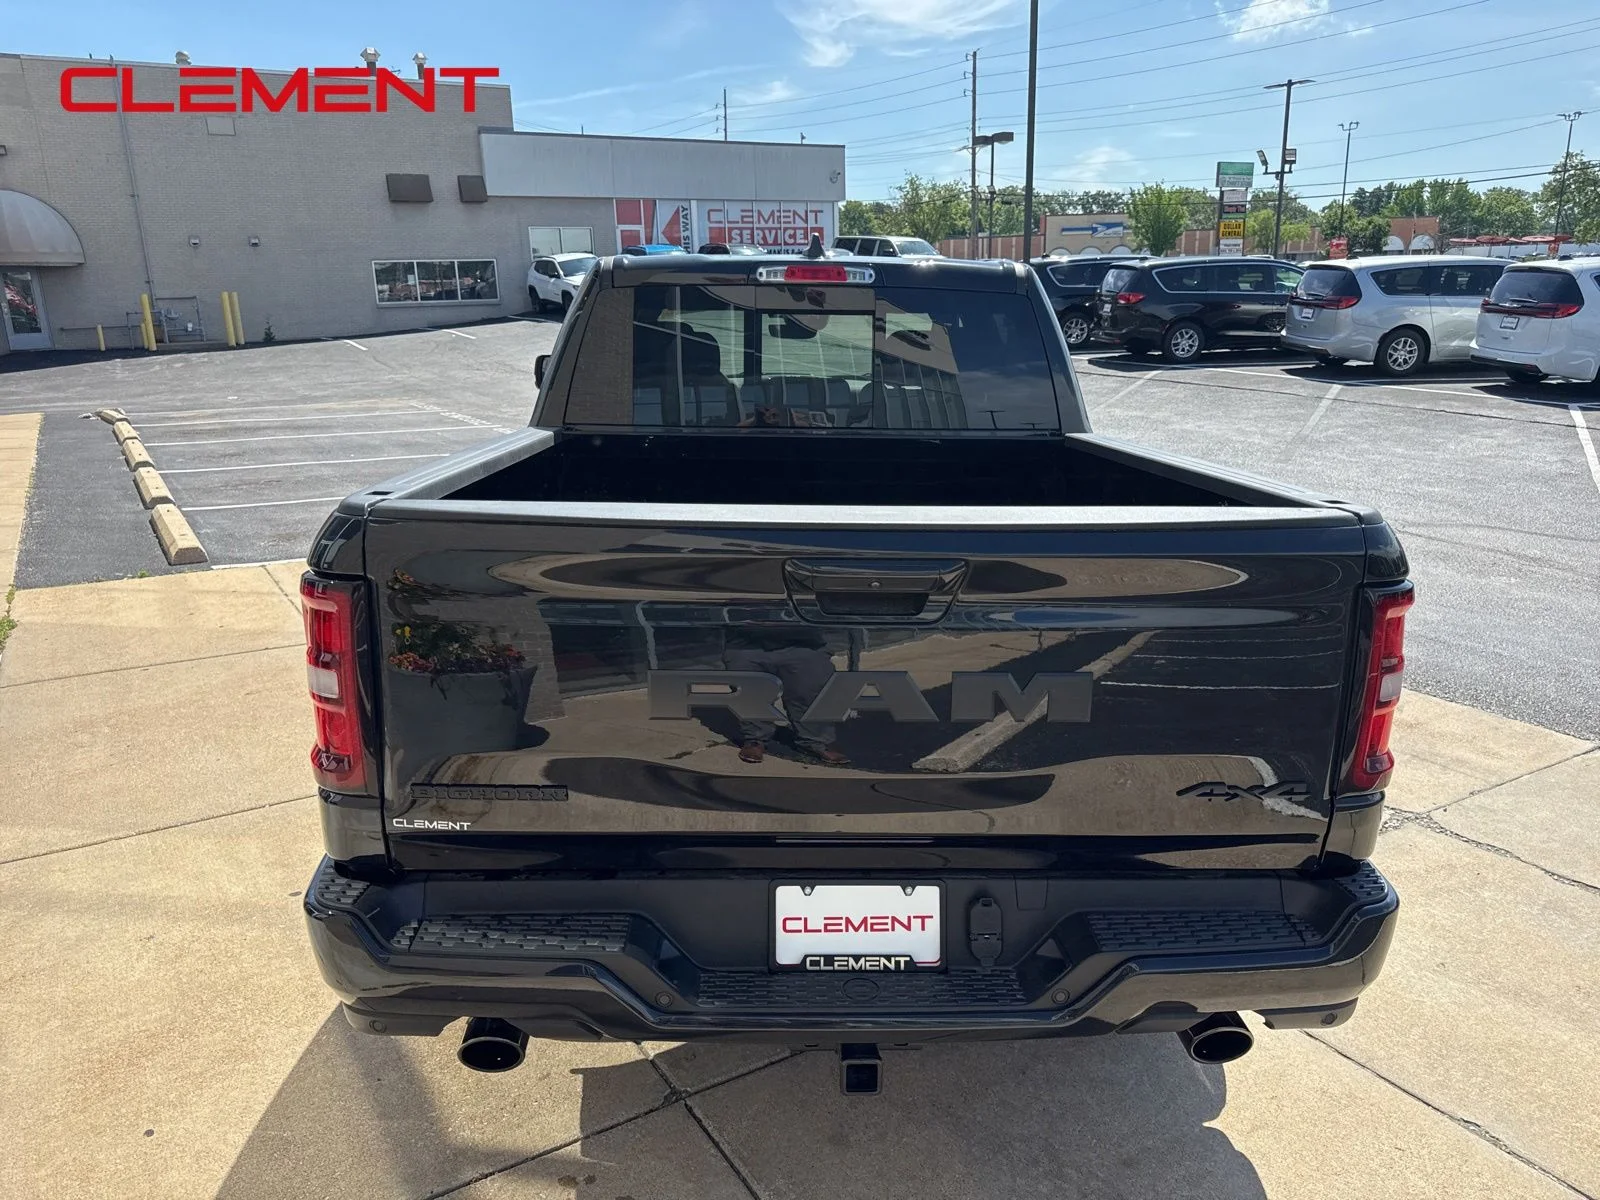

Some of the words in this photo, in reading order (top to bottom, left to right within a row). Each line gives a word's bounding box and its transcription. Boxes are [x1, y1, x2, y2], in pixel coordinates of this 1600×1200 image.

[680, 204, 690, 232] WAY
[707, 209, 824, 225] CLEMENT
[731, 229, 805, 243] SERVICE
[648, 670, 1093, 723] RAM
[410, 783, 568, 801] BIGHORN
[393, 818, 471, 831] CLEMENT
[782, 915, 934, 934] CLEMENT
[806, 956, 911, 971] CLEMENT
